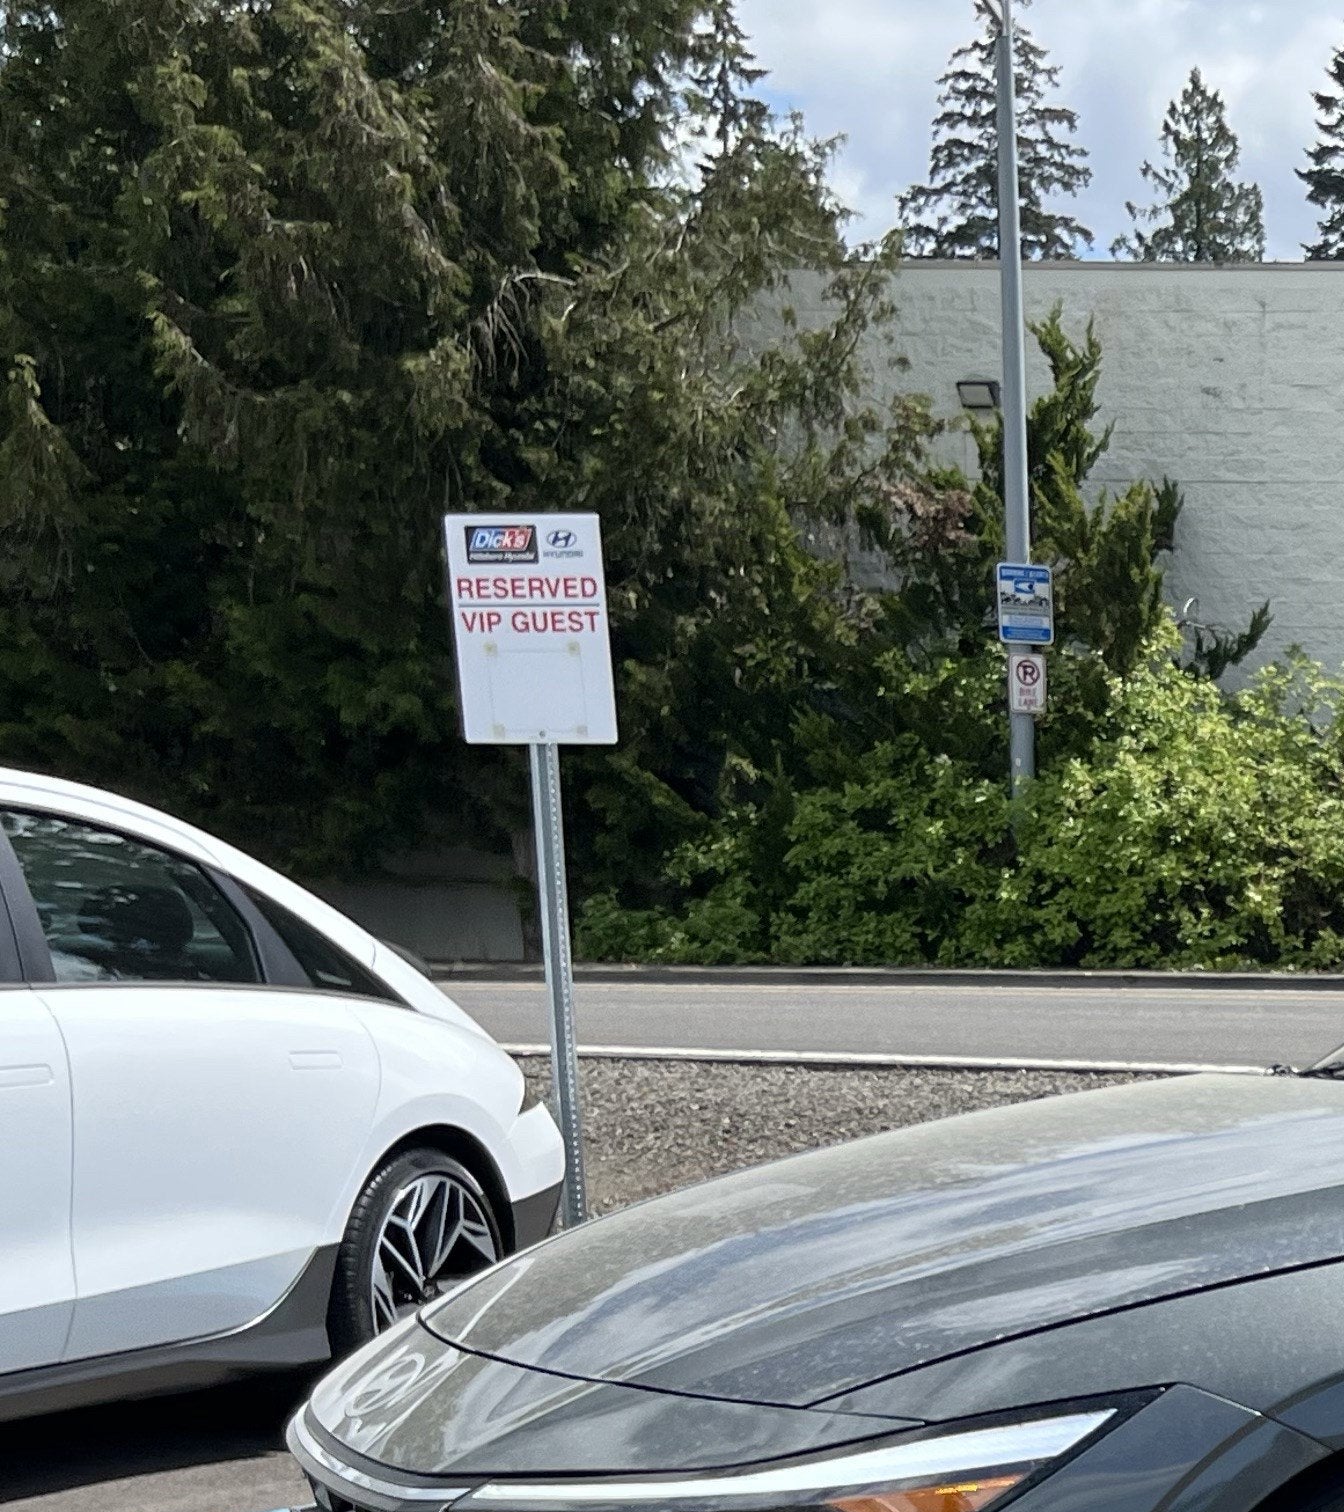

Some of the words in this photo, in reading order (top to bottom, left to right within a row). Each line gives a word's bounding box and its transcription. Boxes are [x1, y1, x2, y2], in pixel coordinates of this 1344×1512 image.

[456, 577, 598, 599] RESERVED
[461, 611, 502, 633] VIP
[511, 610, 600, 633] GUEST
